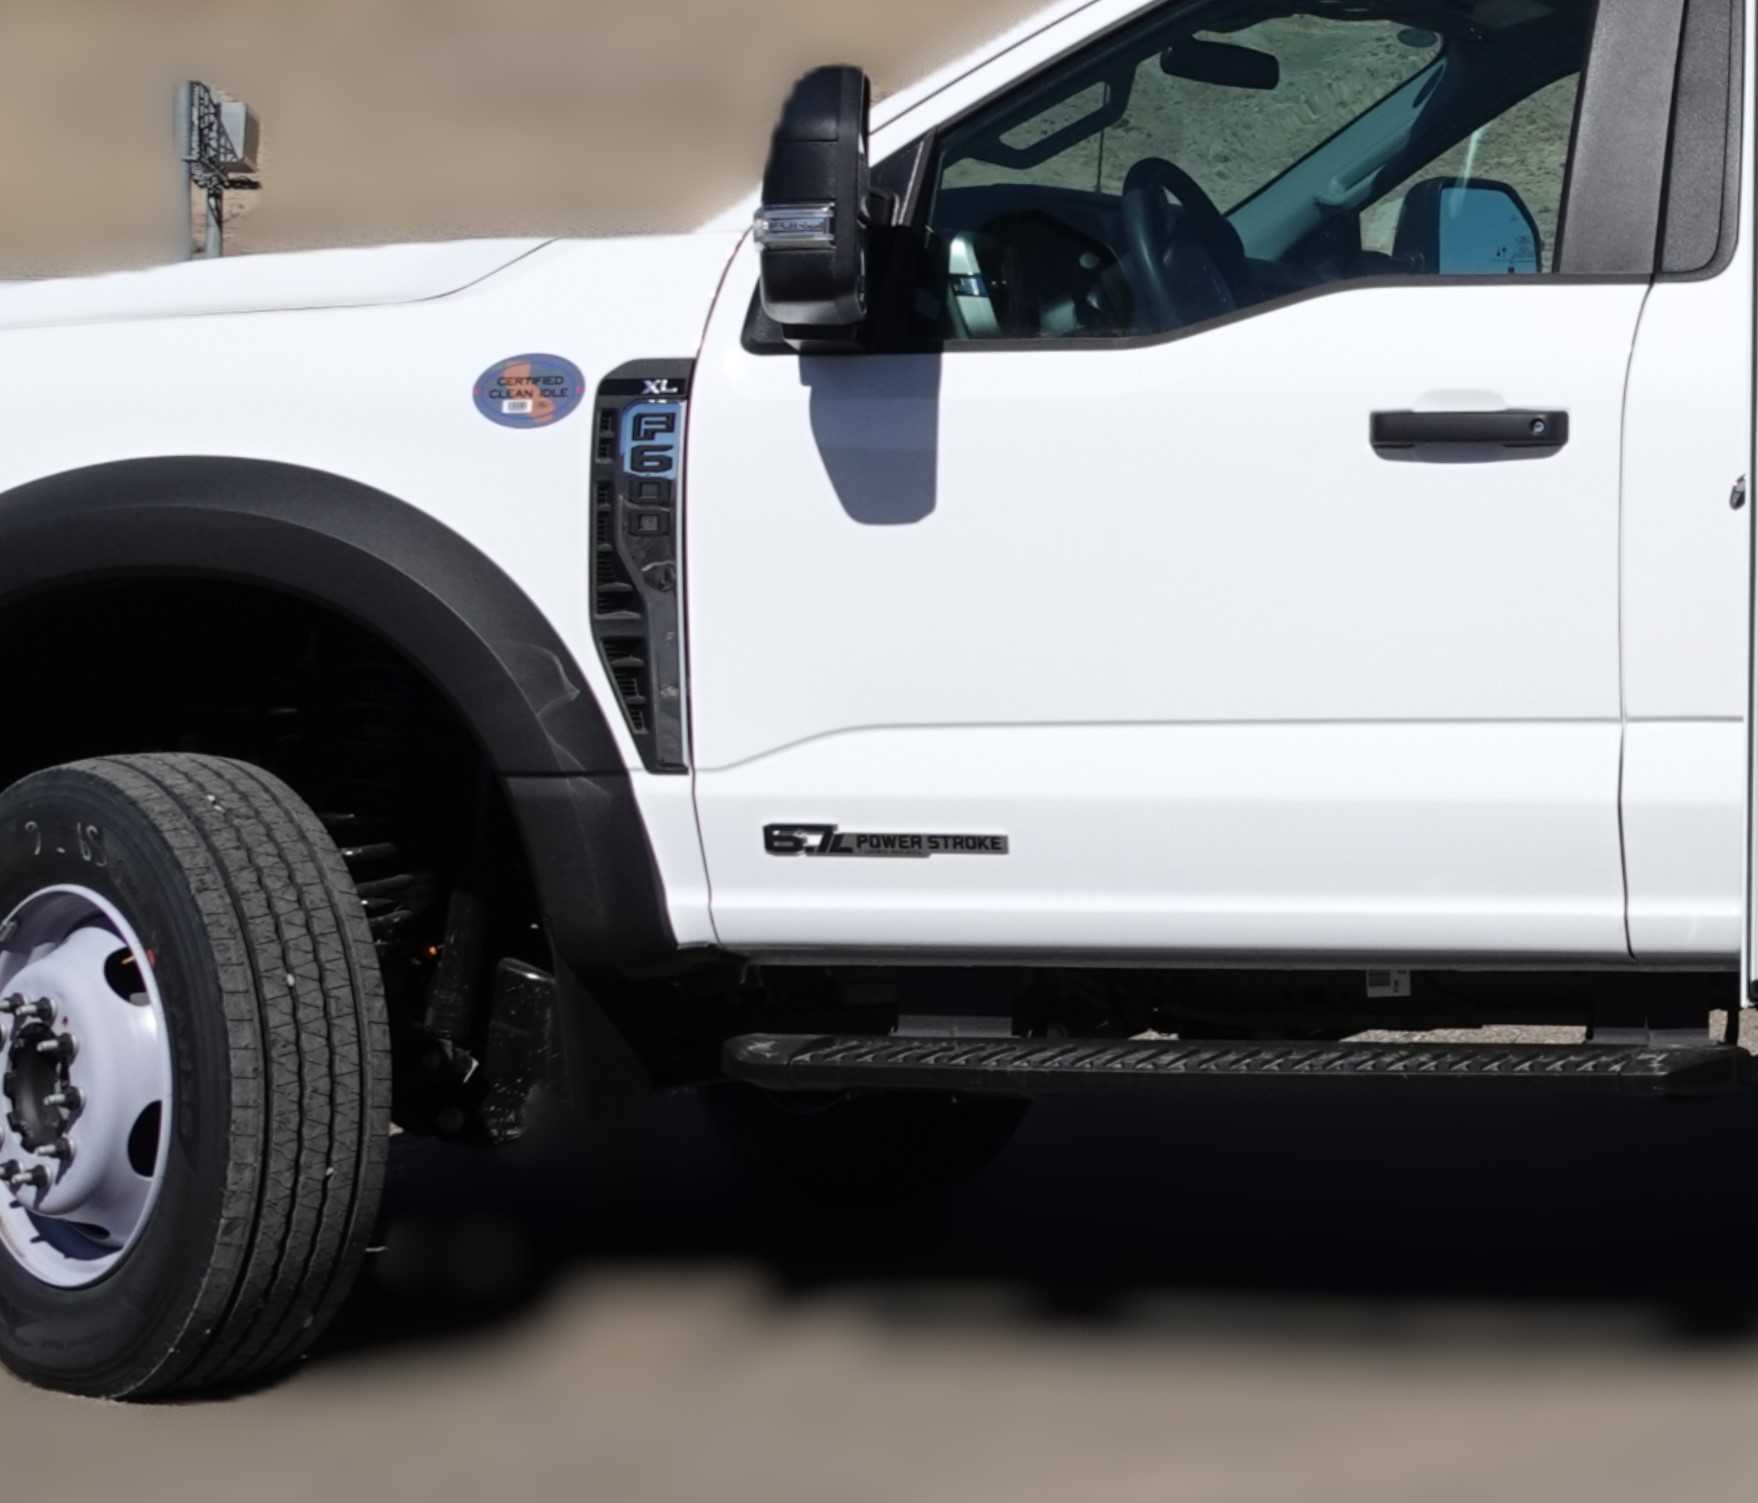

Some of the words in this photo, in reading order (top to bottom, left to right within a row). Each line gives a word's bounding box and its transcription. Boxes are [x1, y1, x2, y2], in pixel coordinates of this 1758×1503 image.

[497, 376, 564, 386] CERTIFIED
[641, 379, 678, 394] XL
[488, 388, 533, 399] CLEAN
[540, 388, 569, 397] IDLE
[762, 823, 854, 856] 6.7L
[857, 834, 922, 849] POWER
[928, 835, 1003, 851] STROKE
